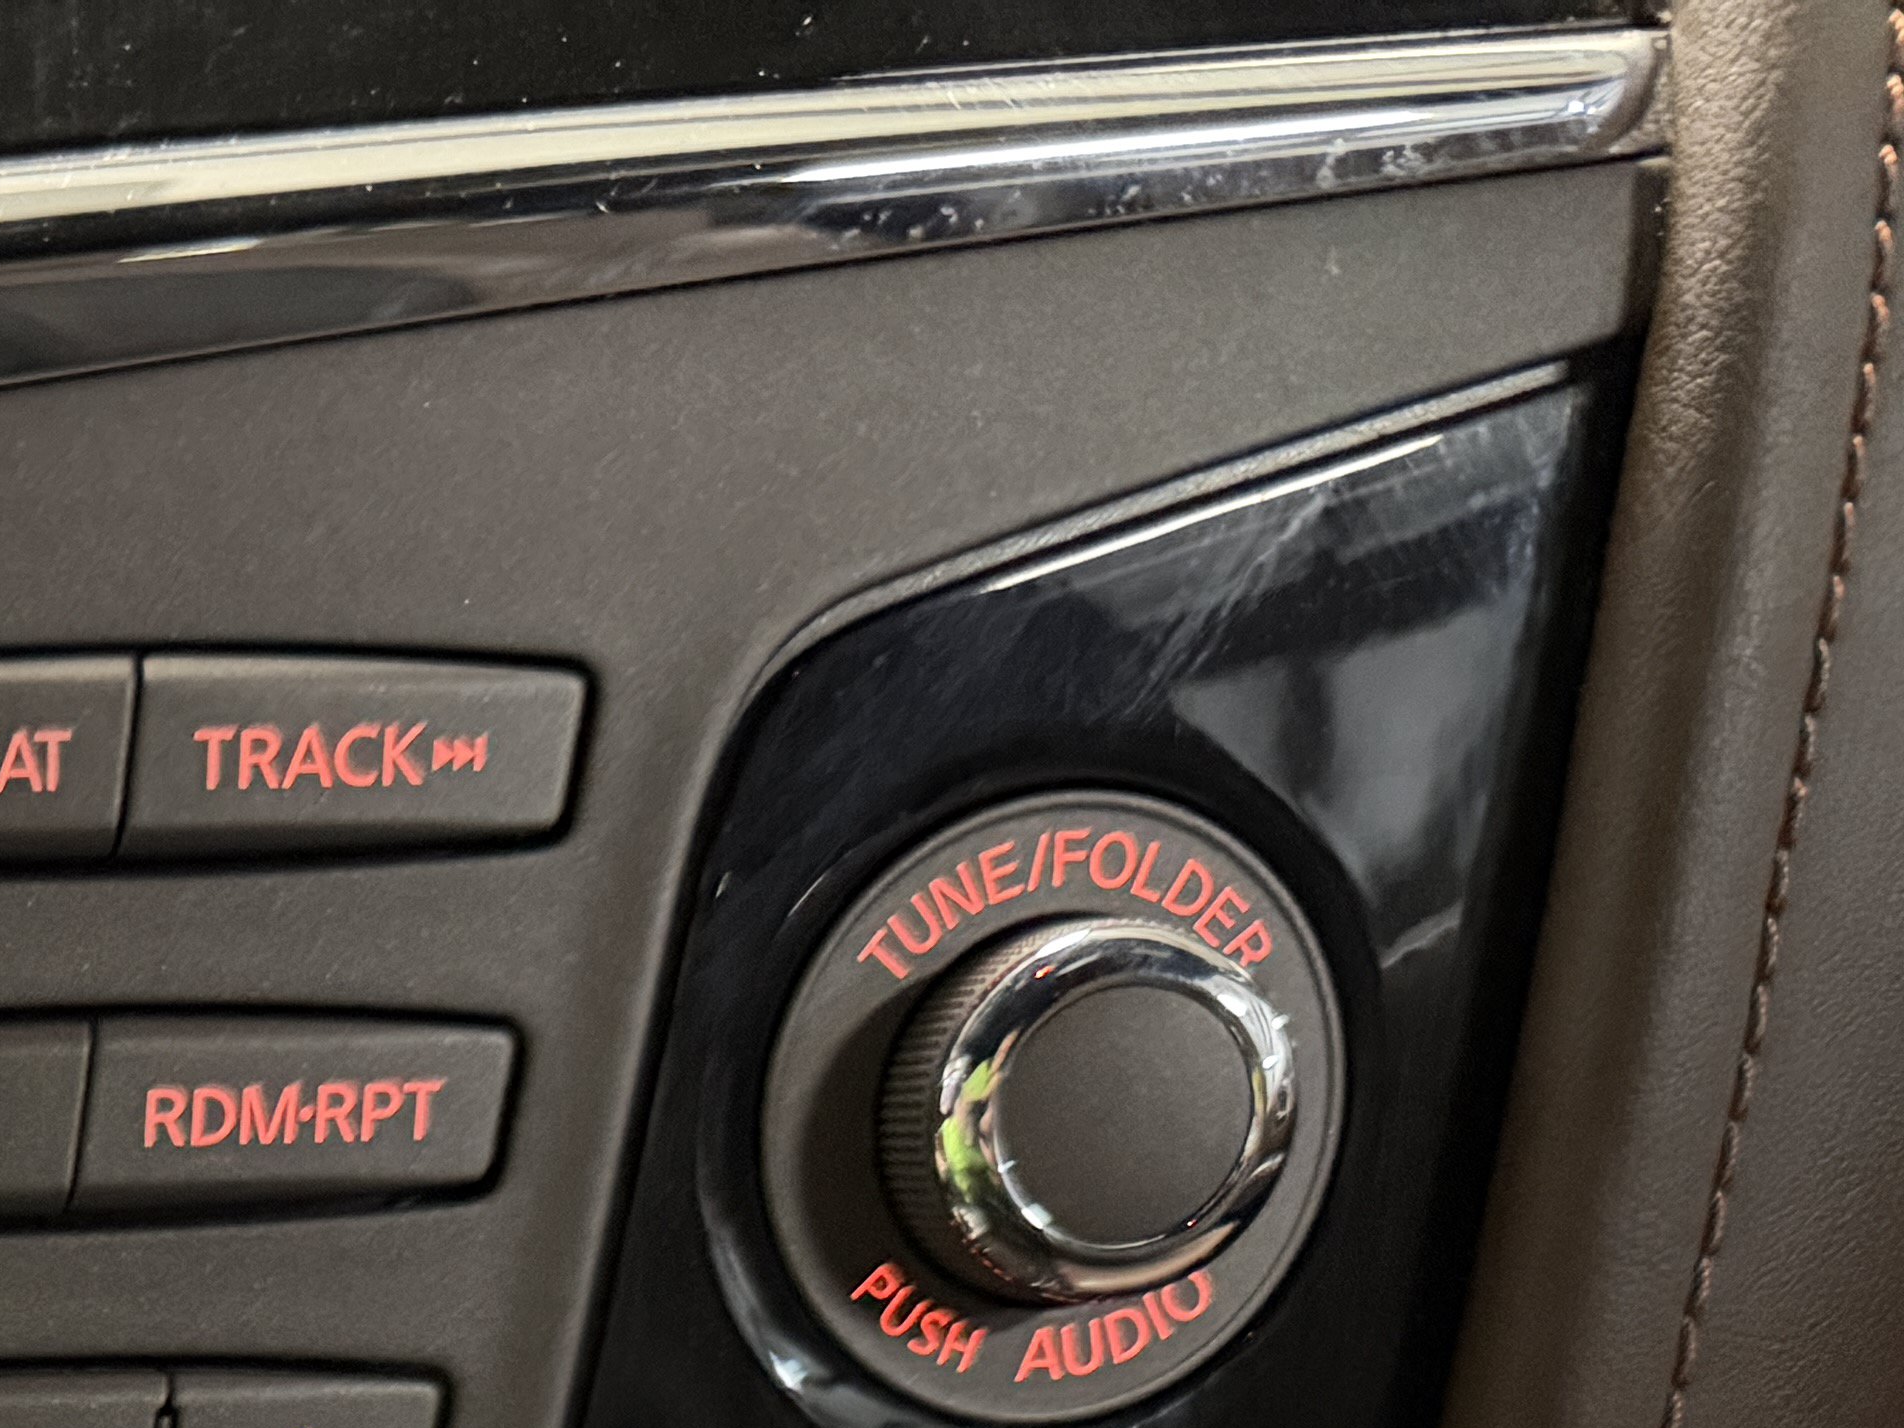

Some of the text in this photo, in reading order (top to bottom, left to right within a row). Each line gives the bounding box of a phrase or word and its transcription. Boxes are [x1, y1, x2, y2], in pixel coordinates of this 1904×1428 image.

[193, 722, 426, 791] TRACK
[856, 826, 1275, 982] TUNE/FOLDER
[848, 1262, 1214, 1385] PUSH AUDIO
